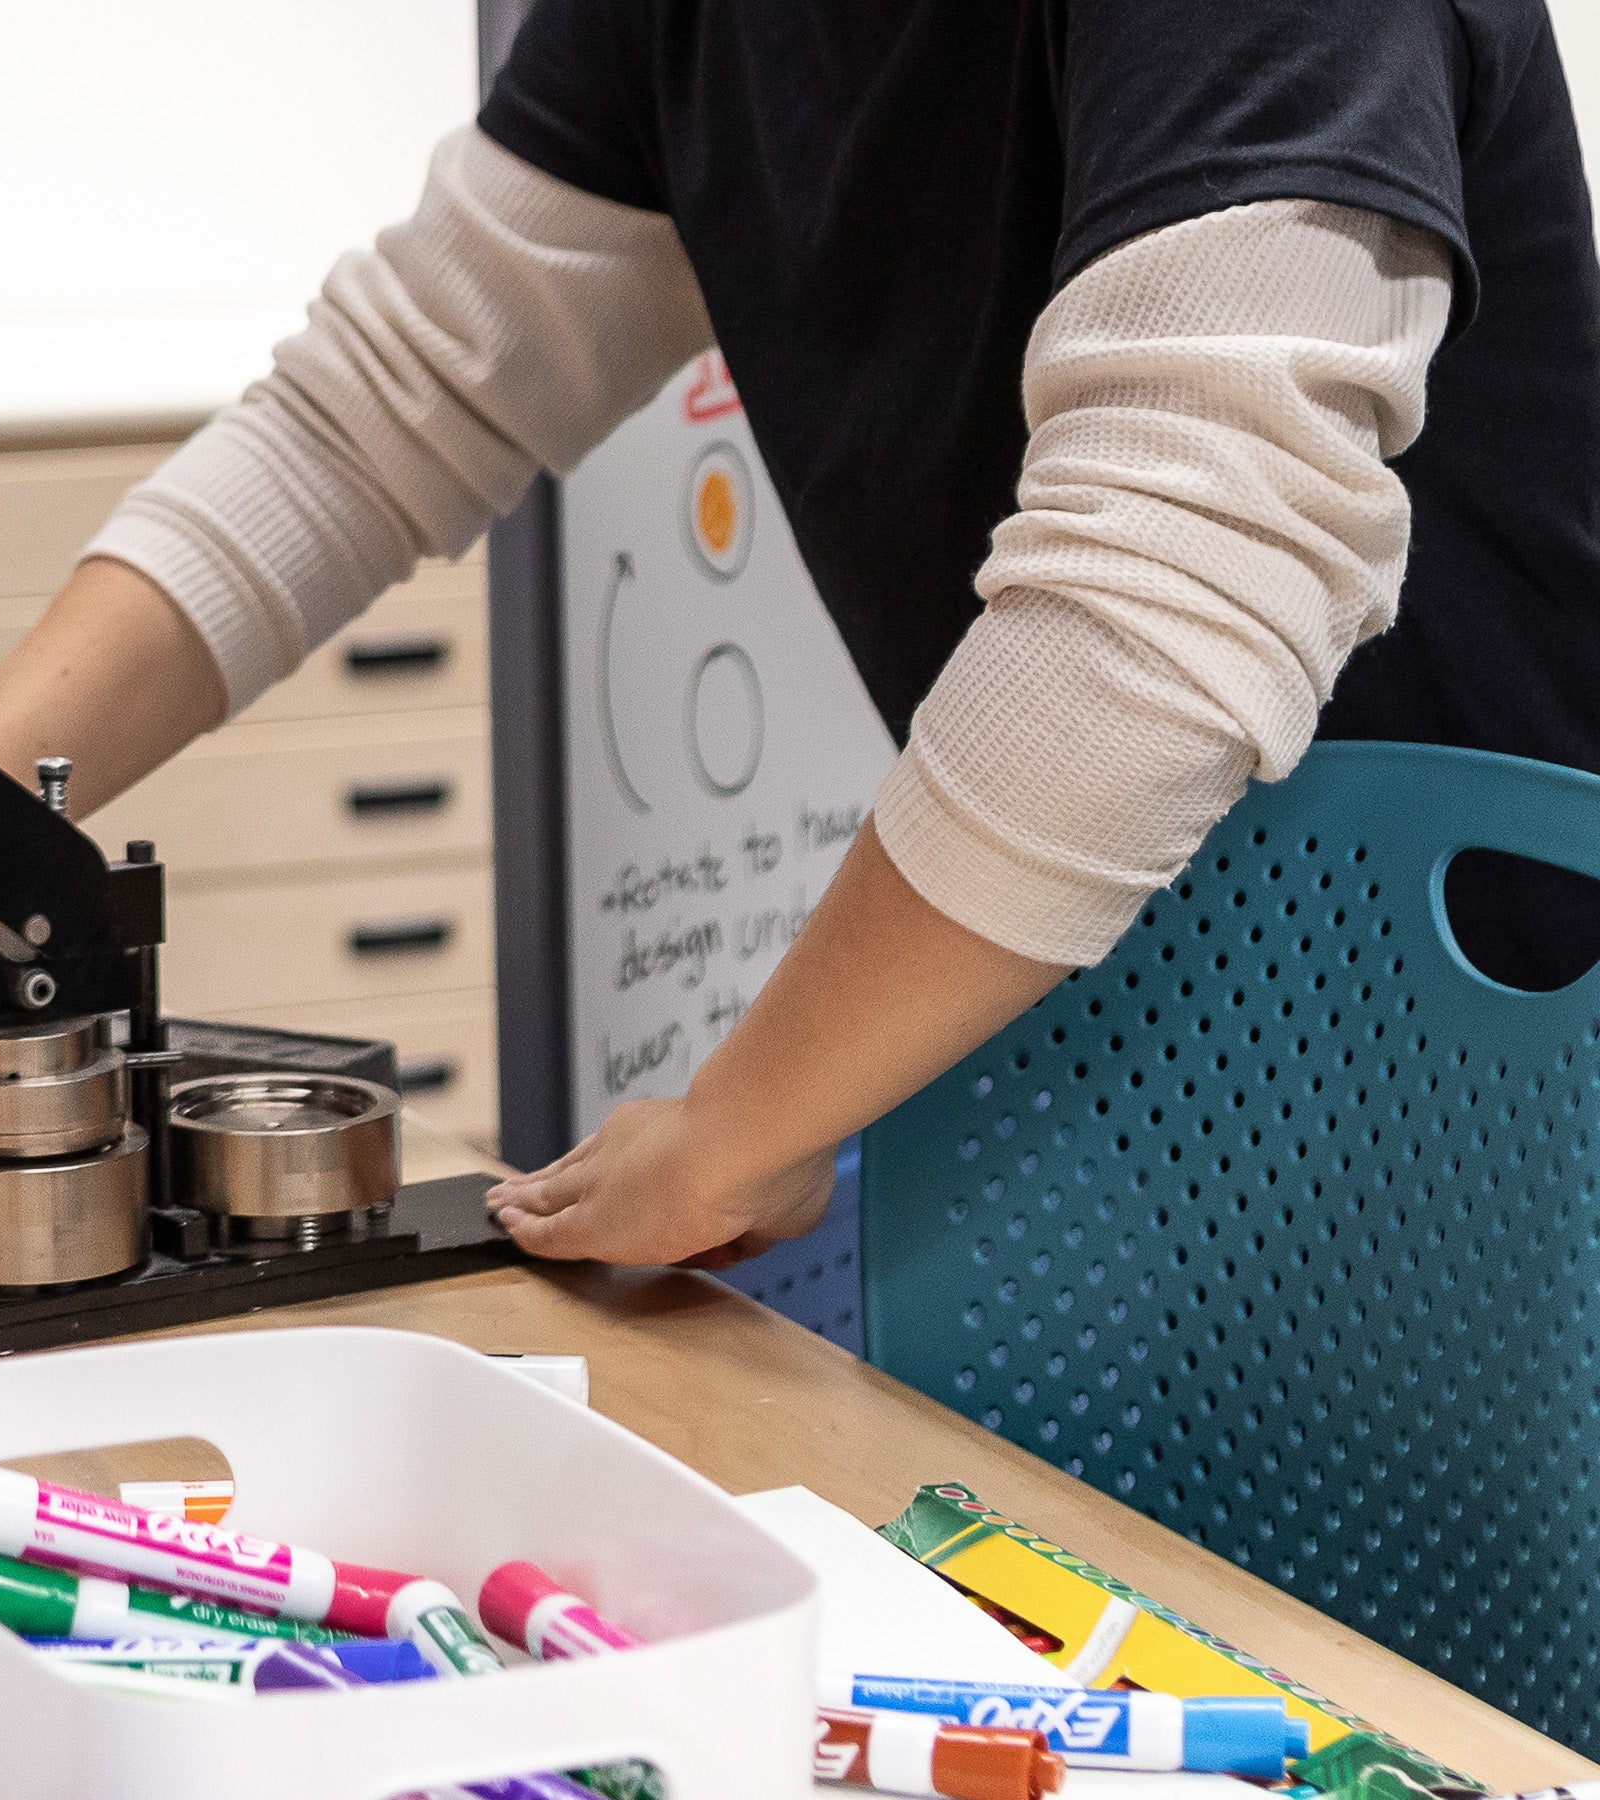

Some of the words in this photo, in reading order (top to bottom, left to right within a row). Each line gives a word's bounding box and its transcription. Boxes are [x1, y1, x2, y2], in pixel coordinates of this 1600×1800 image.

[740, 822, 782, 874] to
[614, 917, 724, 991] design
[57, 1496, 99, 1521] odor
[191, 1600, 225, 1627] dry
[227, 1611, 280, 1635] erase
[970, 1690, 1121, 1748] EXPO
